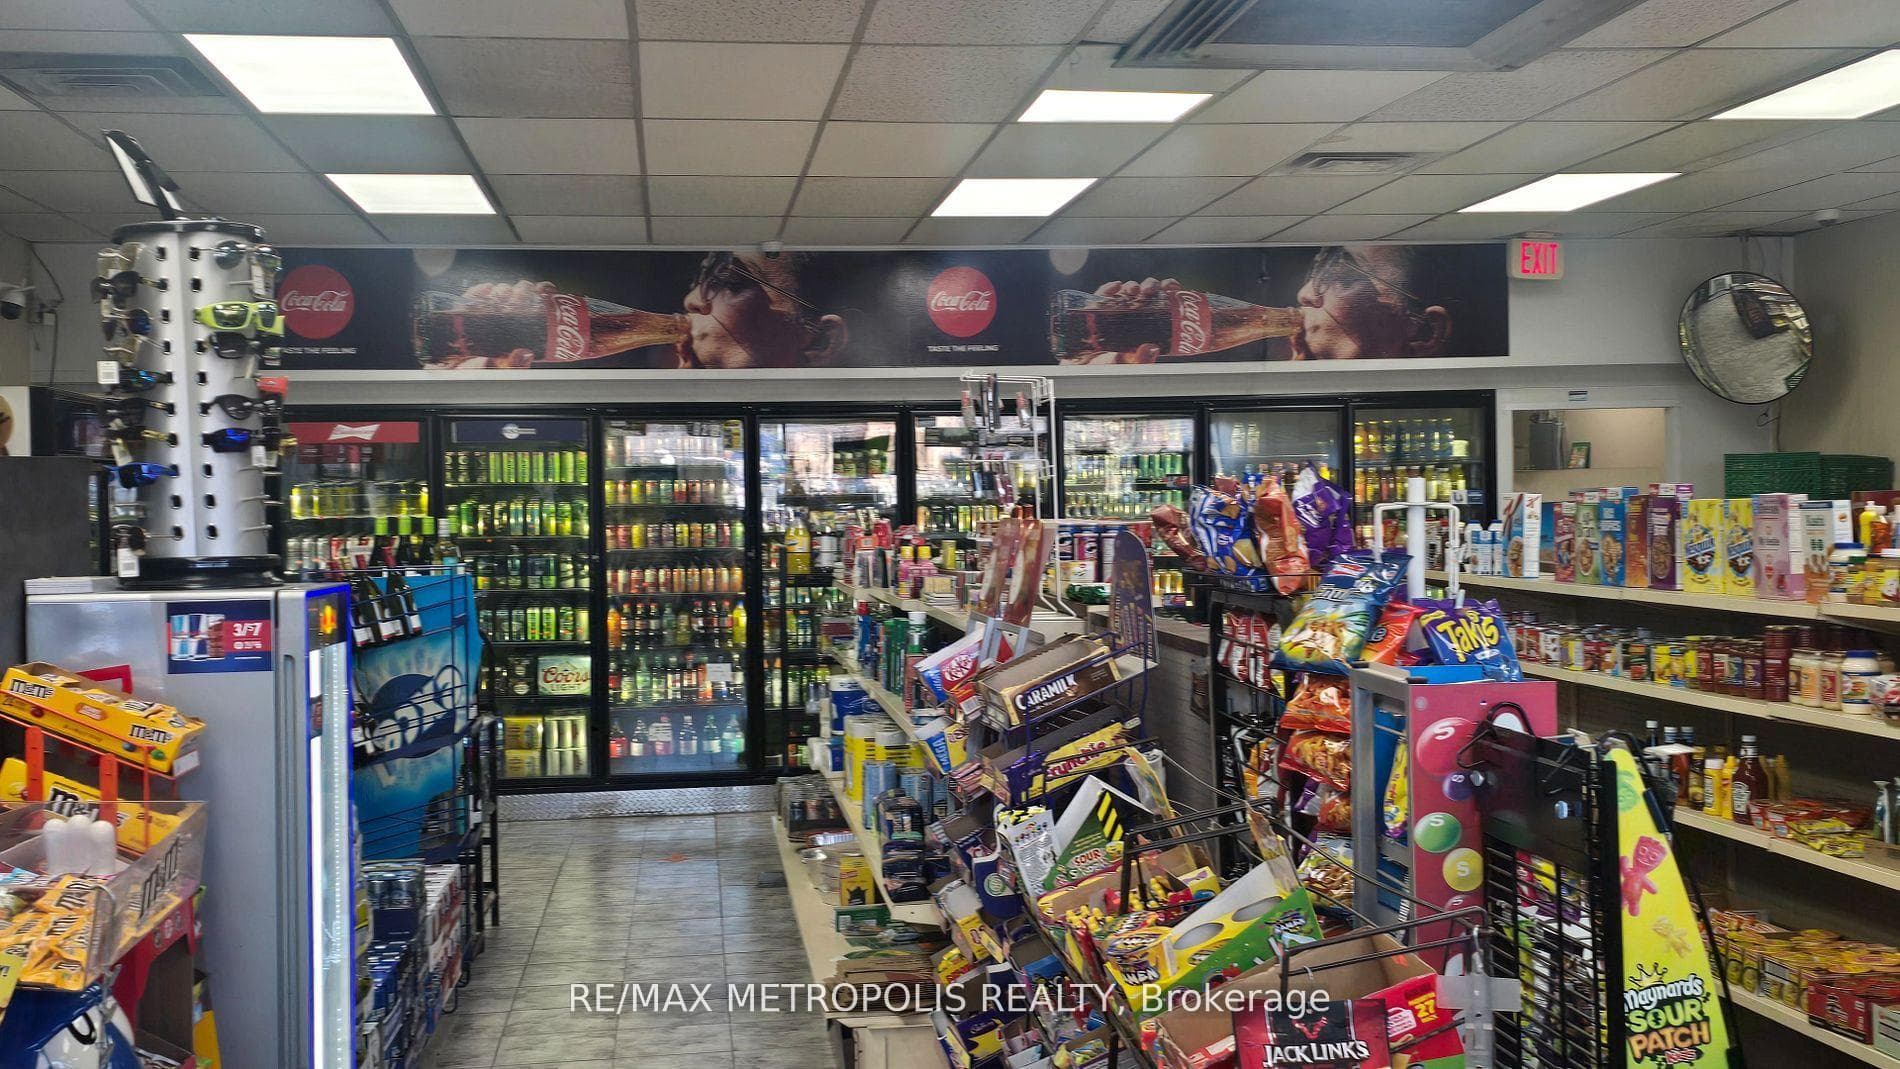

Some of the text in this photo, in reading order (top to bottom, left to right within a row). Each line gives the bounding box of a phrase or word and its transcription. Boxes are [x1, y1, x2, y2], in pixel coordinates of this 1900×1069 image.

[1520, 242, 1559, 275] EXIT
[967, 344, 1000, 352] FEELING
[542, 666, 590, 683] Coors
[551, 684, 581, 692] LIGHT
[1429, 814, 1445, 827] S
[1073, 848, 1102, 866] SOUR
[1456, 861, 1471, 877] S
[1629, 998, 1703, 1033] SOUR
[1628, 1021, 1711, 1060] PATCH
[1263, 1044, 1313, 1067] JACK
